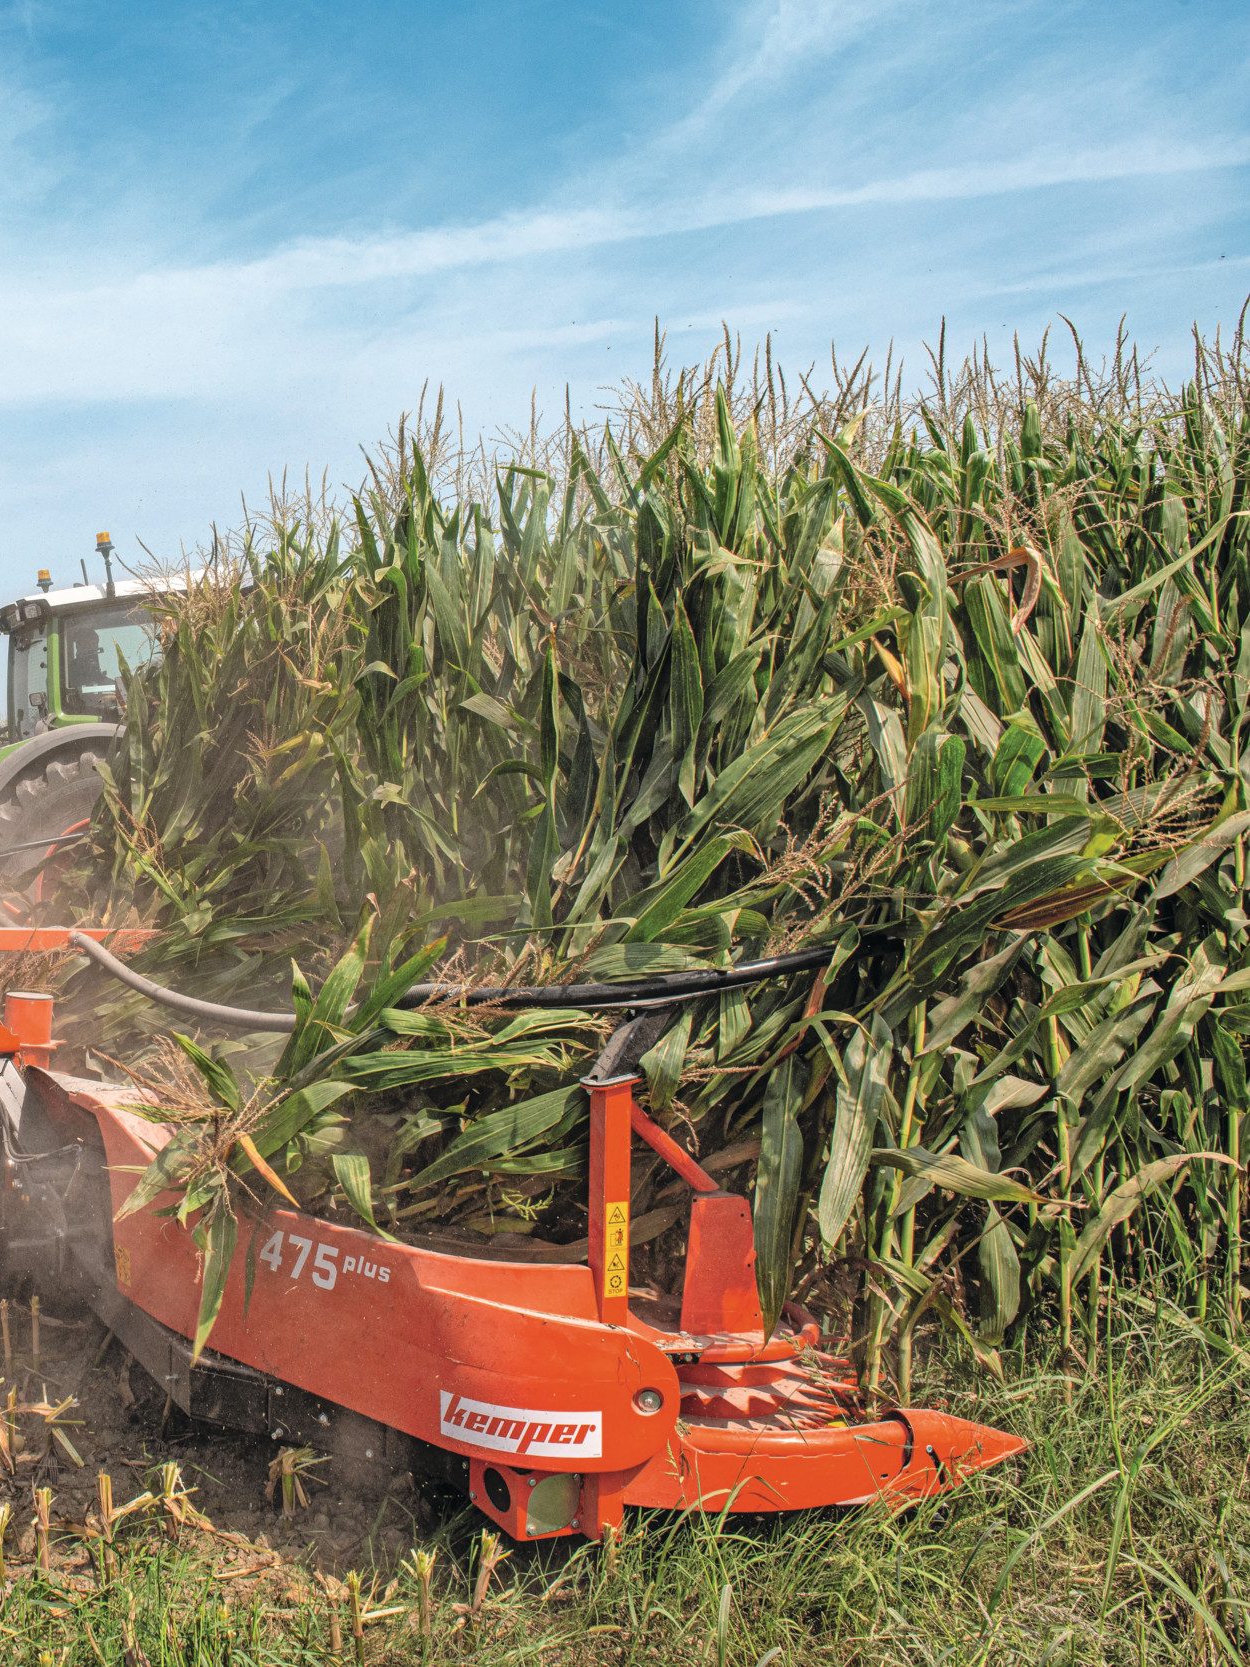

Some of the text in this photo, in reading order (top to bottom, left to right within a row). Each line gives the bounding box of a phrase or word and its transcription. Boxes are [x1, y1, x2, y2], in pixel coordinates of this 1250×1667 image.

[259, 1230, 391, 1291] 475 plus
[443, 1394, 596, 1454] kemper
